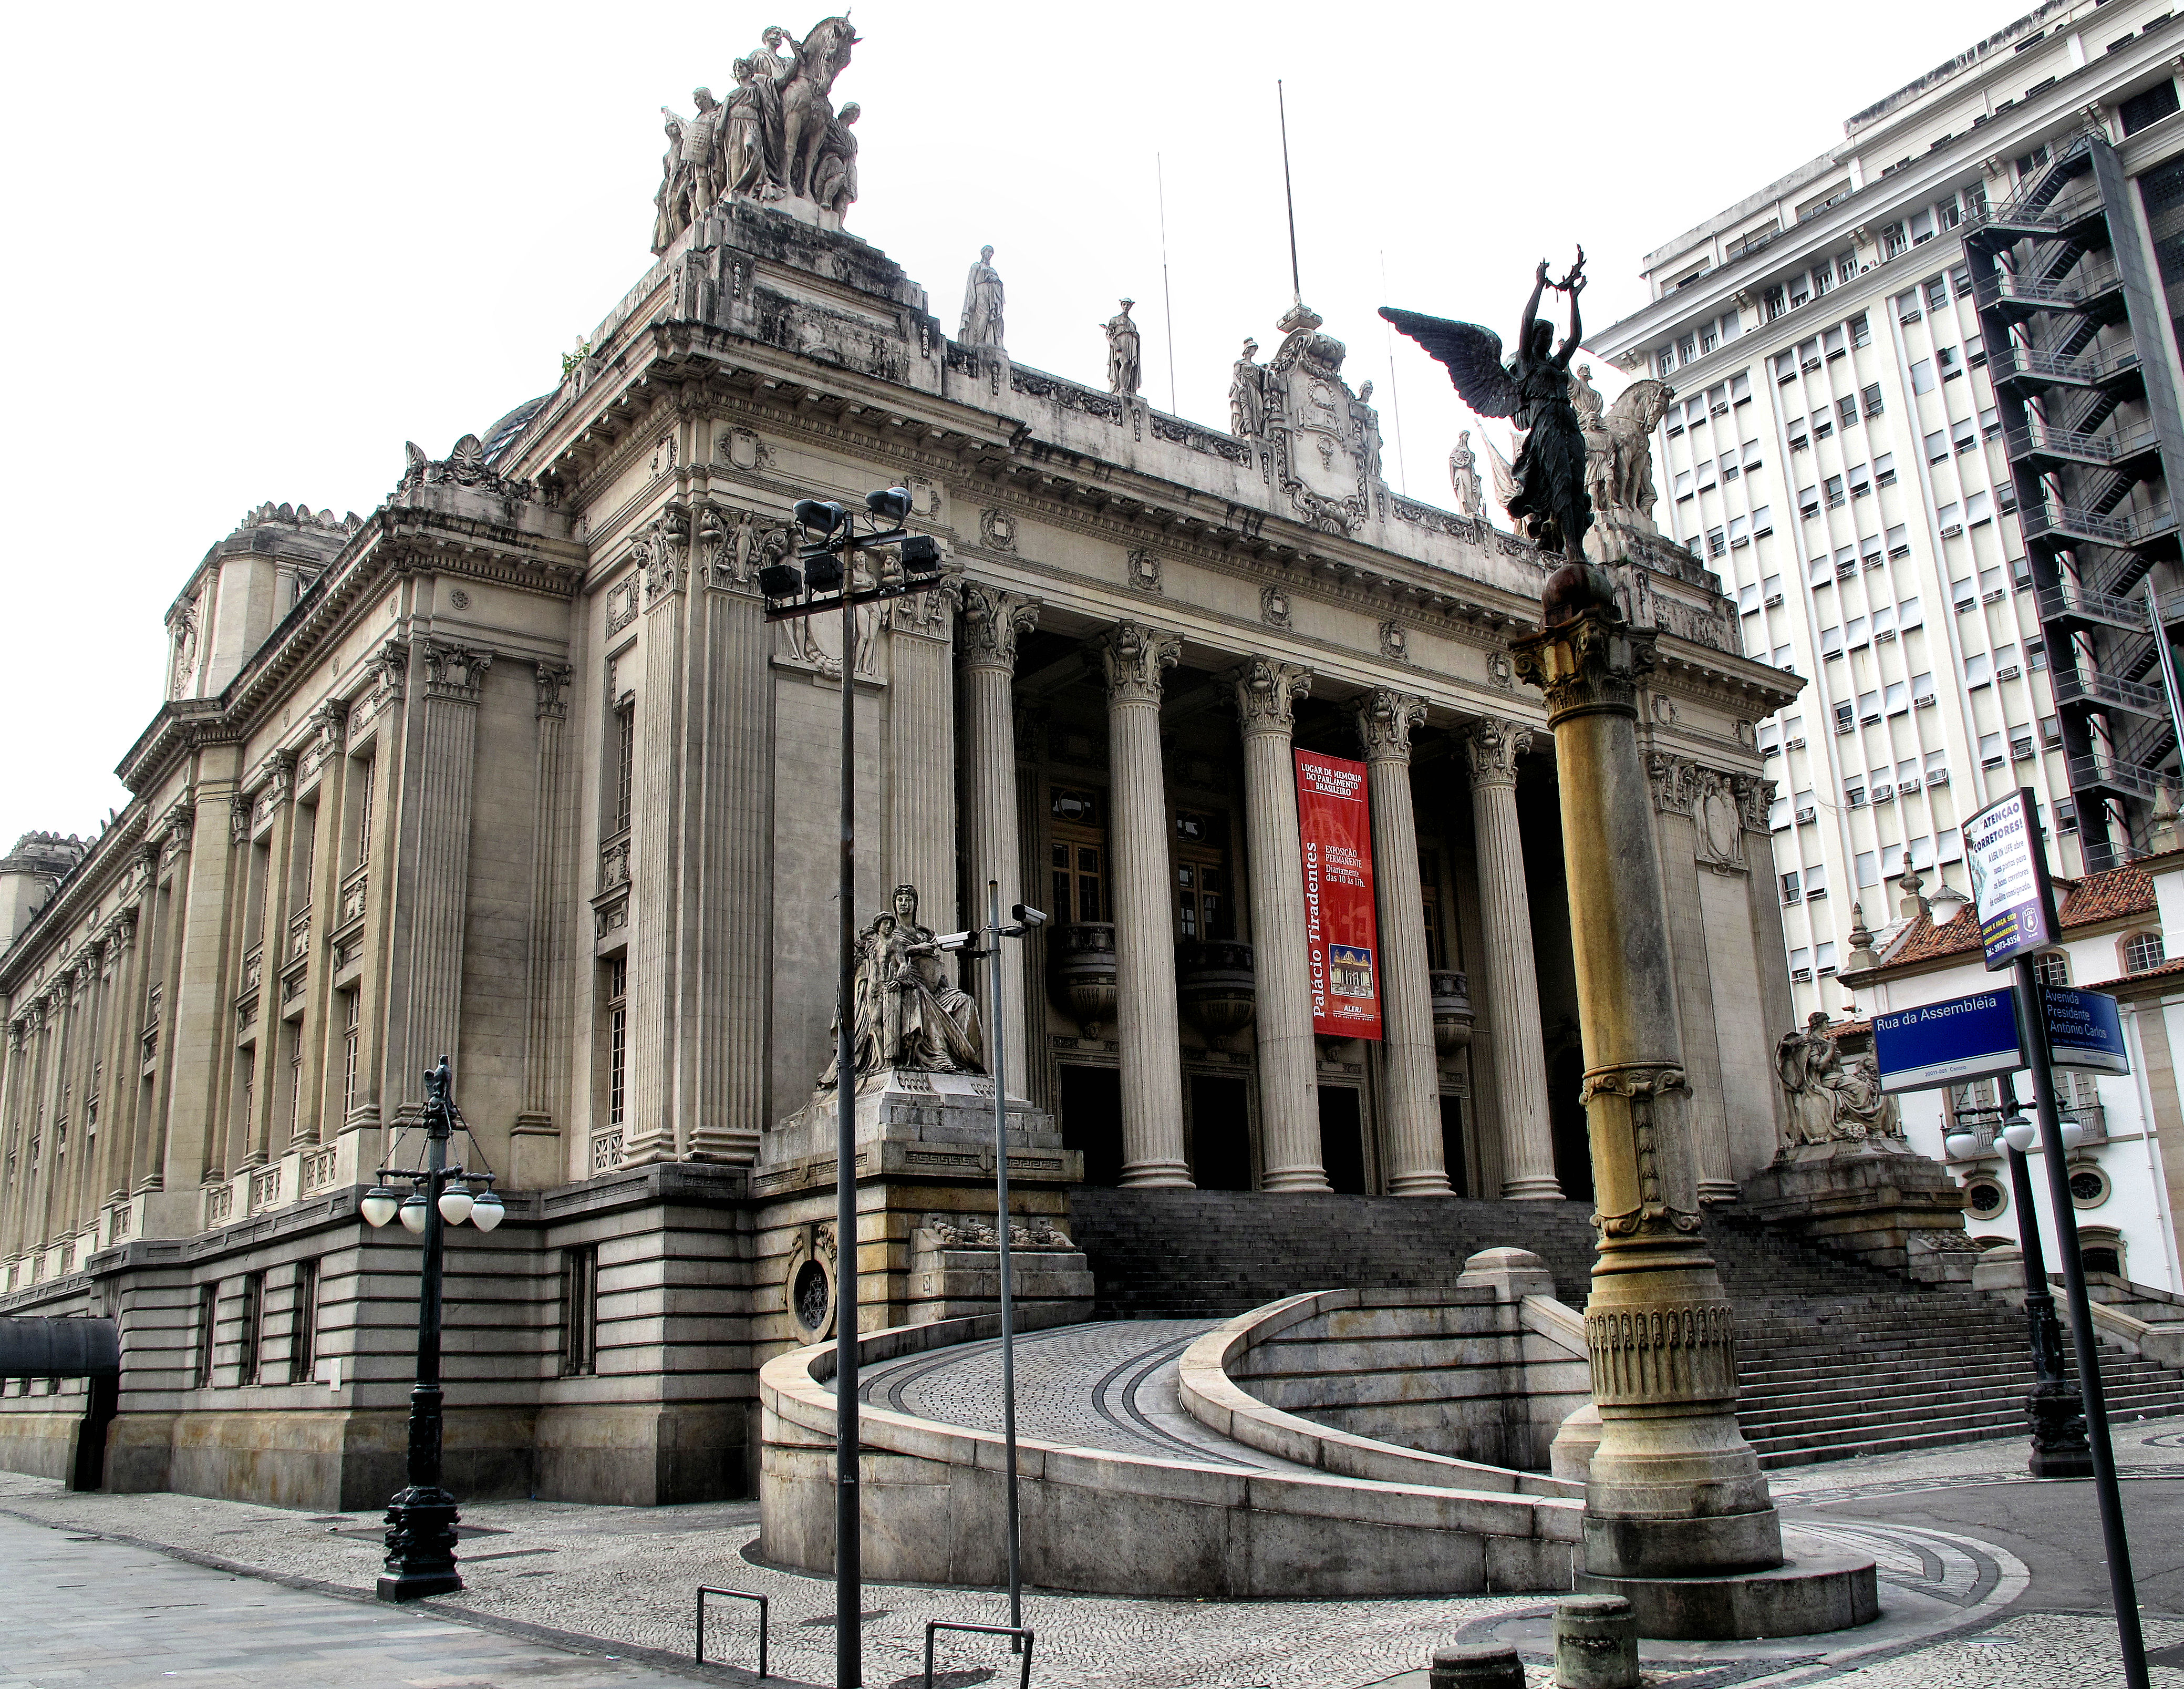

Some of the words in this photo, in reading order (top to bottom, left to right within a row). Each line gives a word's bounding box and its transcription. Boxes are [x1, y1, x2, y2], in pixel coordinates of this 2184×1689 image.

[1301, 763, 1323, 775] LUGAR
[1323, 768, 1332, 777] DE
[1333, 770, 1362, 782] MEMÓRIA
[1306, 772, 1316, 781] DO
[1318, 774, 1358, 790] PARLAMENTO
[1316, 781, 1351, 796] BRASILEIRO
[1983, 802, 2020, 830] ATENÇÃO
[1974, 818, 2023, 853] CORRETORES!
[1325, 845, 1357, 858] EXPOSIÇÃO
[2014, 840, 2024, 850] abre
[1325, 853, 1362, 868] PERMANENTE
[2002, 860, 2015, 872] portas
[2016, 854, 2026, 866] para
[1326, 864, 1360, 878] Diariamente
[1326, 872, 1337, 882] das
[1339, 874, 1346, 883] 10
[1347, 876, 1354, 885] às
[2007, 868, 2028, 882] corretores
[1306, 841, 1321, 943] Tiradentes
[1310, 949, 1325, 1018] Palácio
[2045, 988, 2079, 1004] Avenida
[1877, 1018, 1899, 1031] Rua
[1902, 1013, 1917, 1025] da
[1920, 996, 1997, 1022] Assembléia
[2047, 1004, 2090, 1021] Presidente
[2050, 1019, 2083, 1035] Antônio
[2084, 1024, 2107, 1038] Carlos
